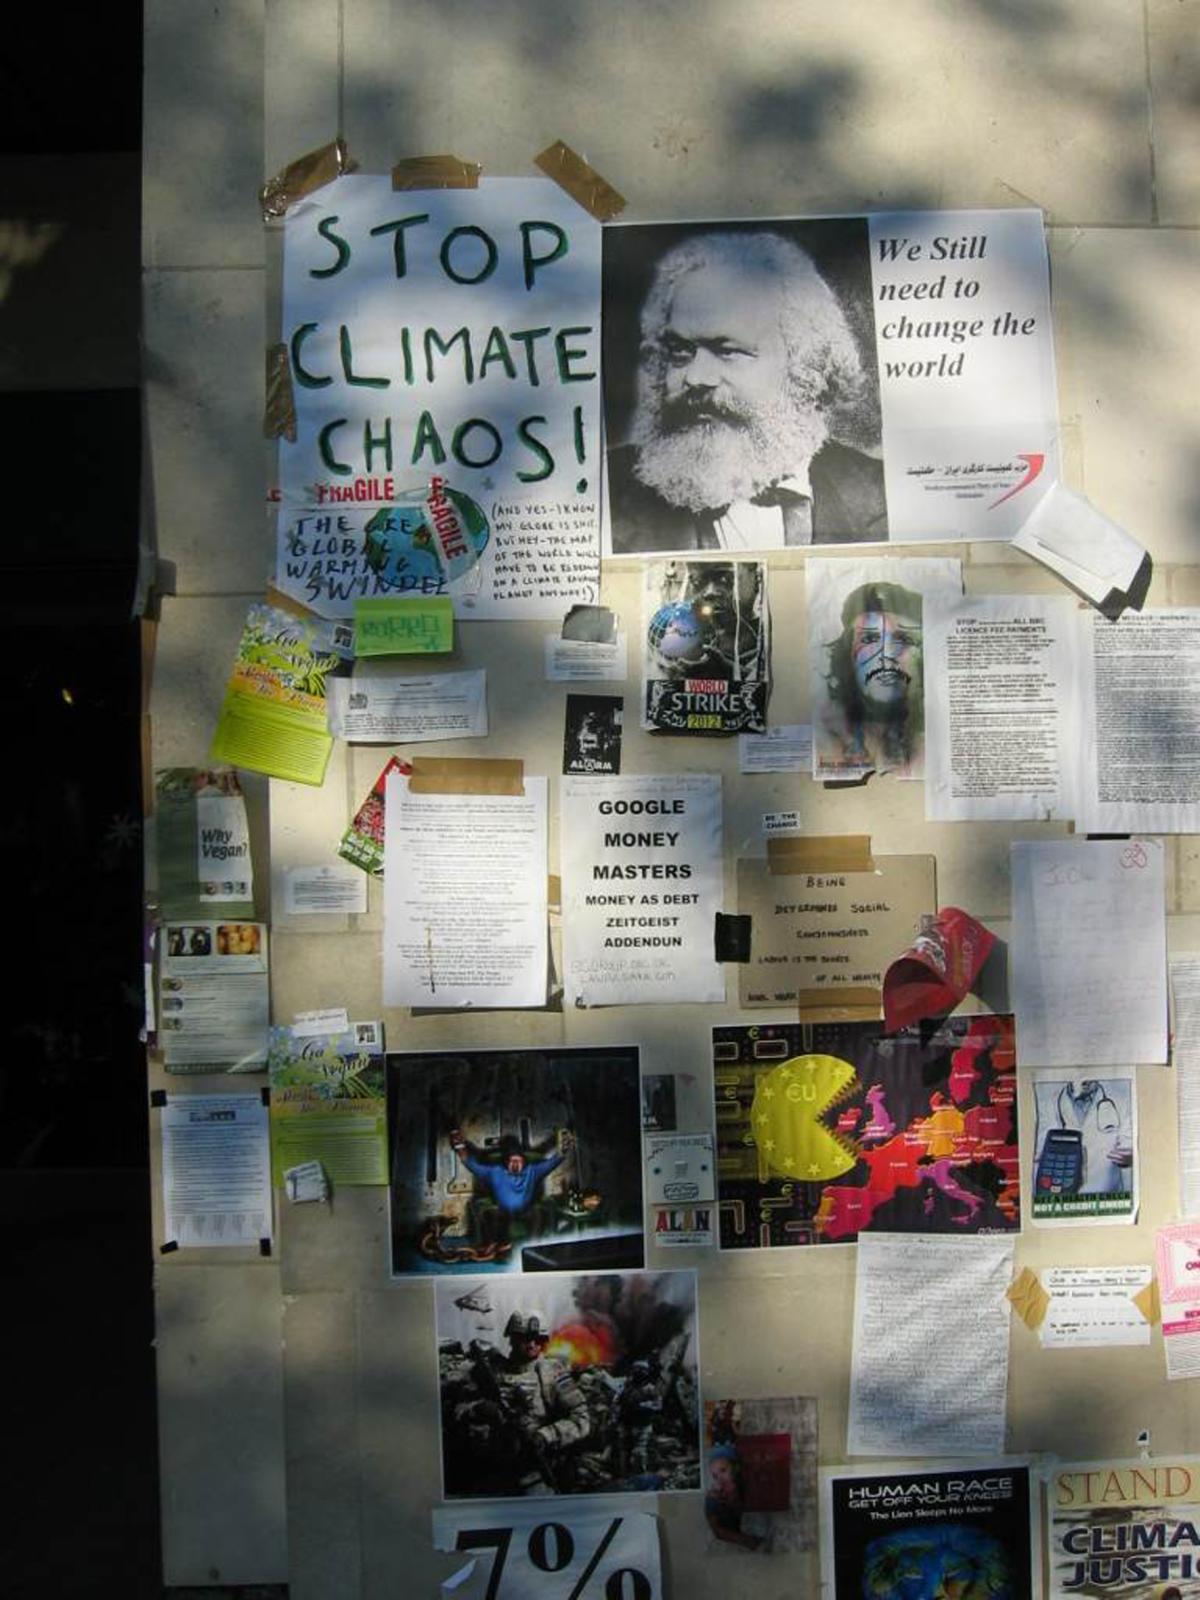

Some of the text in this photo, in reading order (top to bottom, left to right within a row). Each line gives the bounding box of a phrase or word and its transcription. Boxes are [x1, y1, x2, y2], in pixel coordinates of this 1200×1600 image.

[309, 213, 569, 291] STOP
[879, 236, 987, 262] We Still
[879, 275, 980, 301] need to
[882, 312, 1035, 344] change the
[290, 322, 596, 389] CLIMATE
[886, 352, 965, 378] world
[318, 405, 589, 494] CHAOS!
[296, 516, 355, 536] THE
[292, 537, 393, 556] GLOBAL
[672, 692, 741, 712] STRIKE
[599, 800, 685, 815] GOOGLE
[202, 829, 233, 844] Why
[605, 832, 680, 847] MONEY
[202, 842, 248, 860] Vegan?
[593, 864, 692, 880] MASTERS
[806, 876, 846, 888] BEING
[585, 894, 700, 905] MONEY AS DEBT
[606, 917, 680, 927] ZEITGEIST
[604, 937, 682, 947] ADDENDUN
[849, 1478, 1013, 1499] HUMAN RACE
[1057, 1467, 1191, 1505] STAND
[849, 1499, 879, 1509] GET
[883, 1497, 913, 1506] OFF
[916, 1494, 960, 1504] YOUR
[871, 1512, 889, 1520] The
[892, 1510, 913, 1519] Lion
